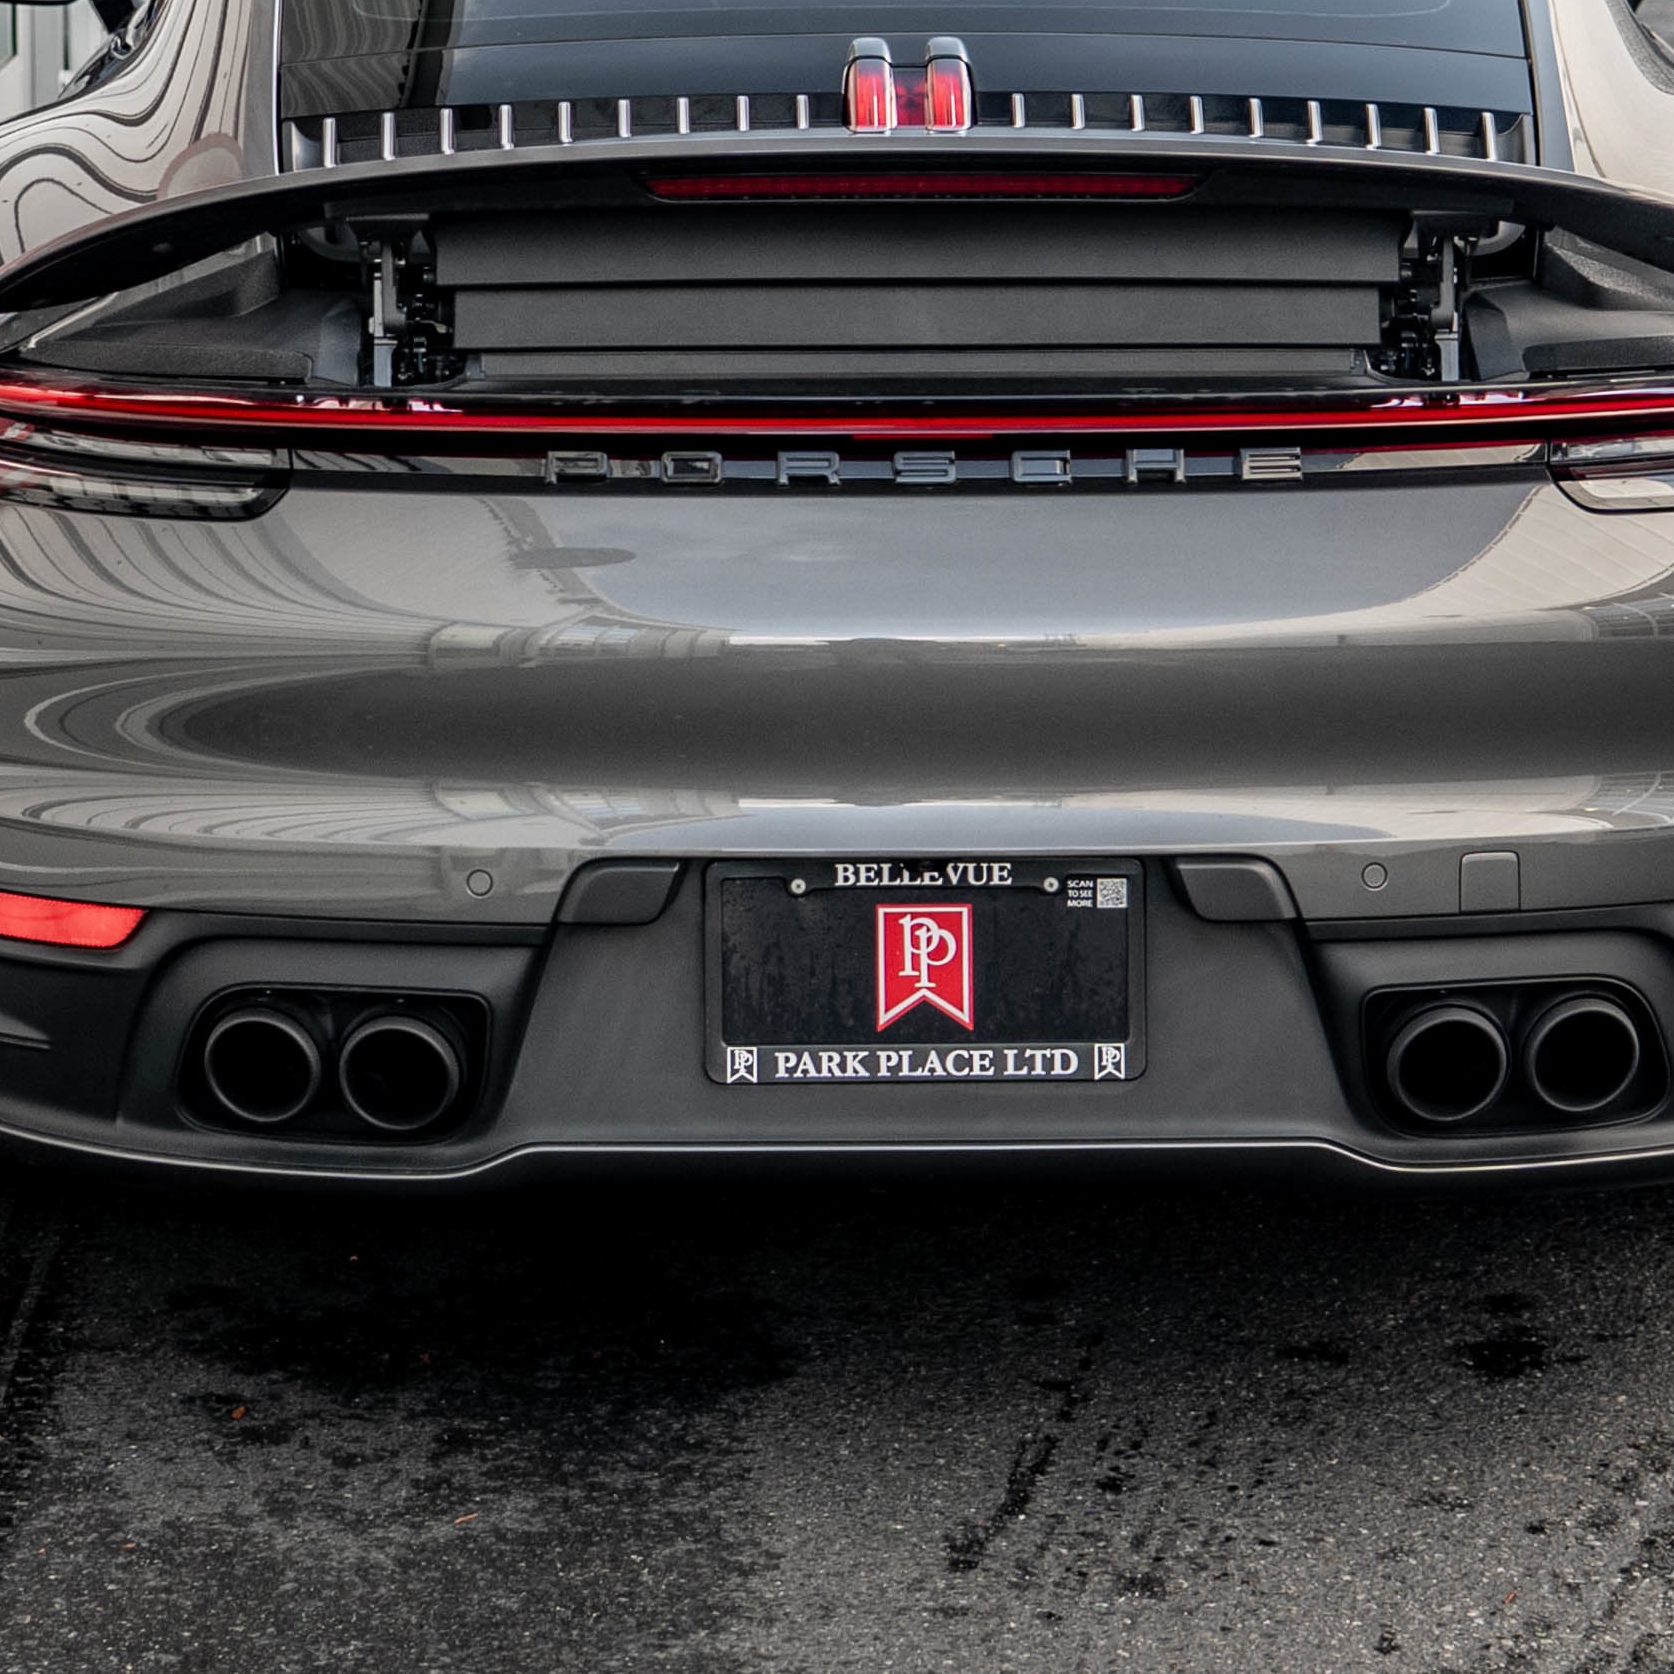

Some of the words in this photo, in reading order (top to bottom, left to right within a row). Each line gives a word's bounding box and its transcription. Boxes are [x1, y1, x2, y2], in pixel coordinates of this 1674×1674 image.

[545, 447, 1303, 485] PORSCHE
[1067, 879, 1094, 888] SCAN
[1068, 889, 1079, 898] TO
[1079, 889, 1094, 898] SEE
[1067, 899, 1094, 908] MORE
[774, 1051, 871, 1078] PARK
[876, 1049, 996, 1076] PLACE
[1003, 1048, 1079, 1075] LTD
